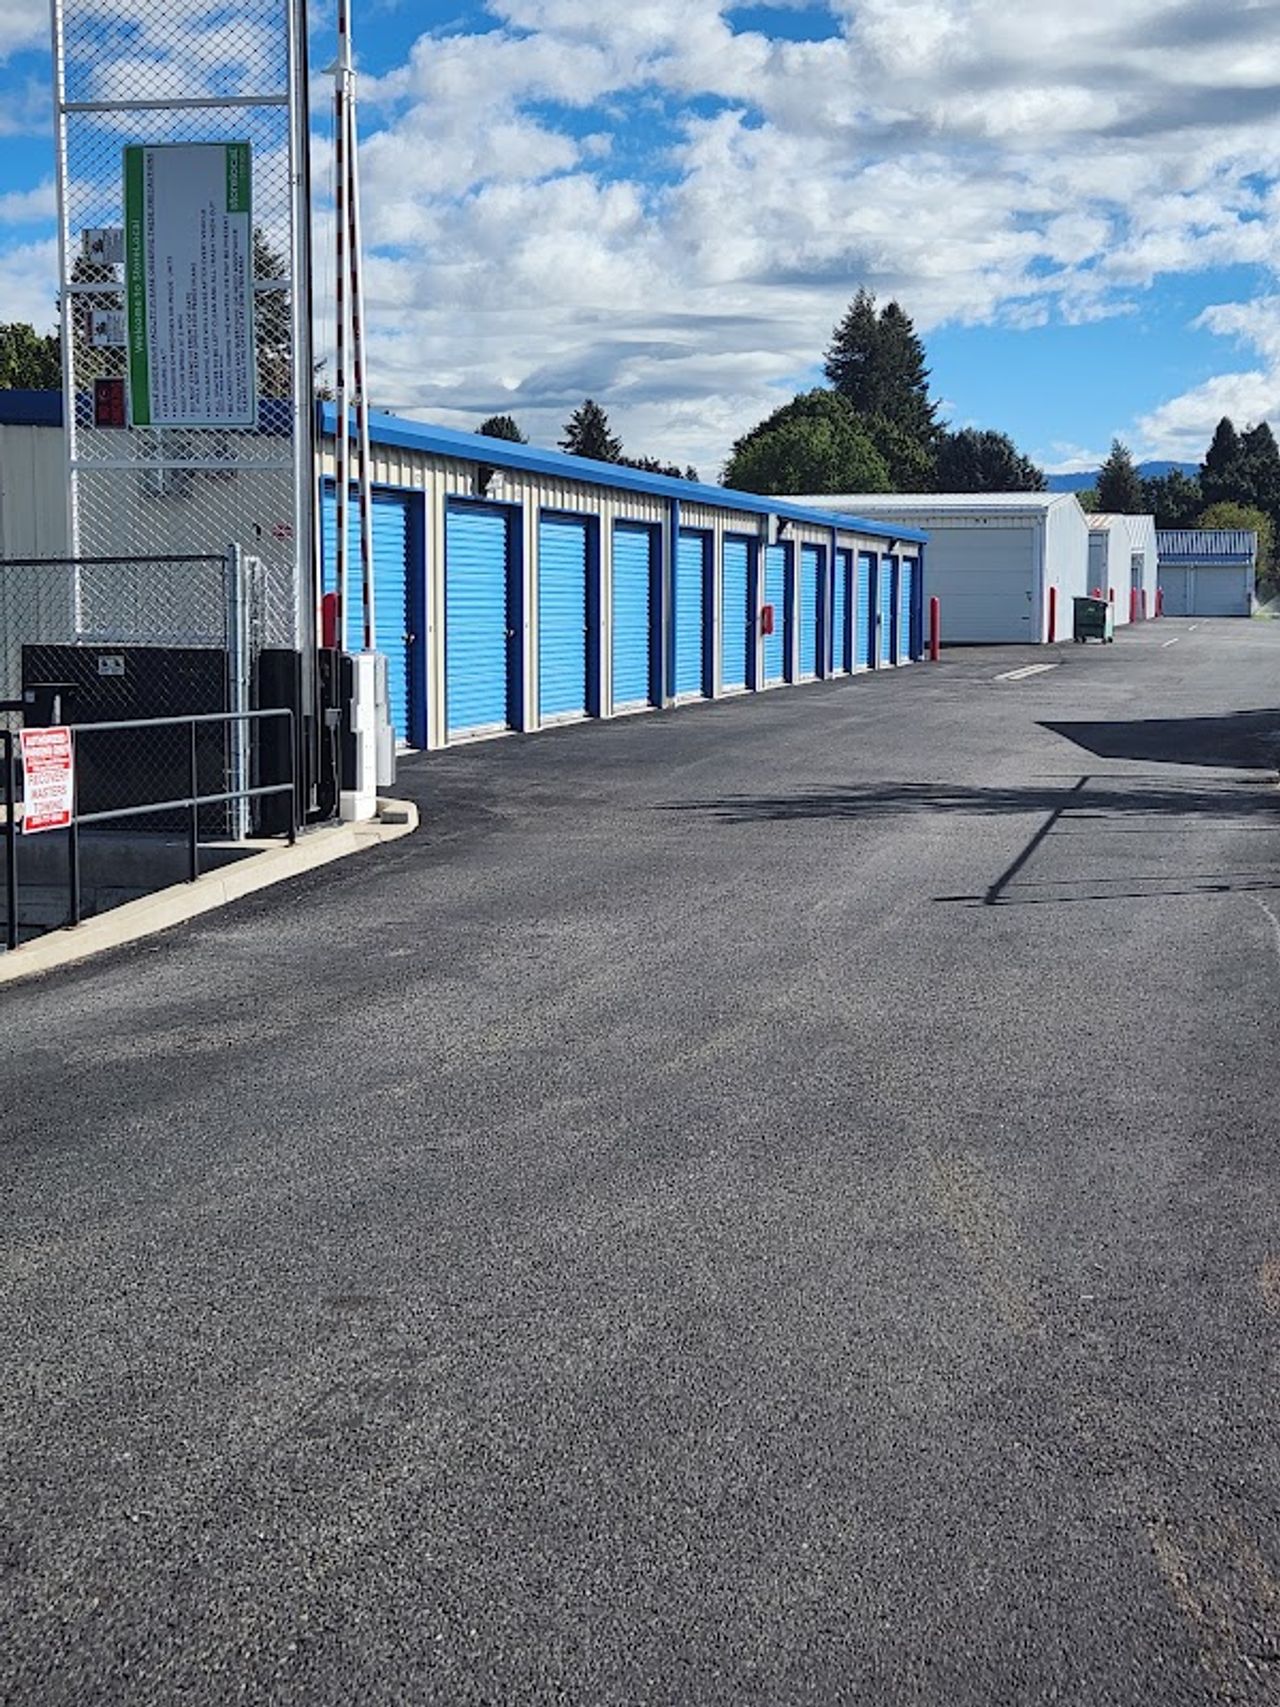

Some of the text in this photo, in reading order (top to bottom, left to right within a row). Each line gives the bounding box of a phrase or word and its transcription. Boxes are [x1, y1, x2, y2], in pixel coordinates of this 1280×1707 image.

[228, 148, 238, 210] storelocal
[132, 220, 144, 352] Welcome to StoreLocal
[31, 785, 67, 799] MASTERS
